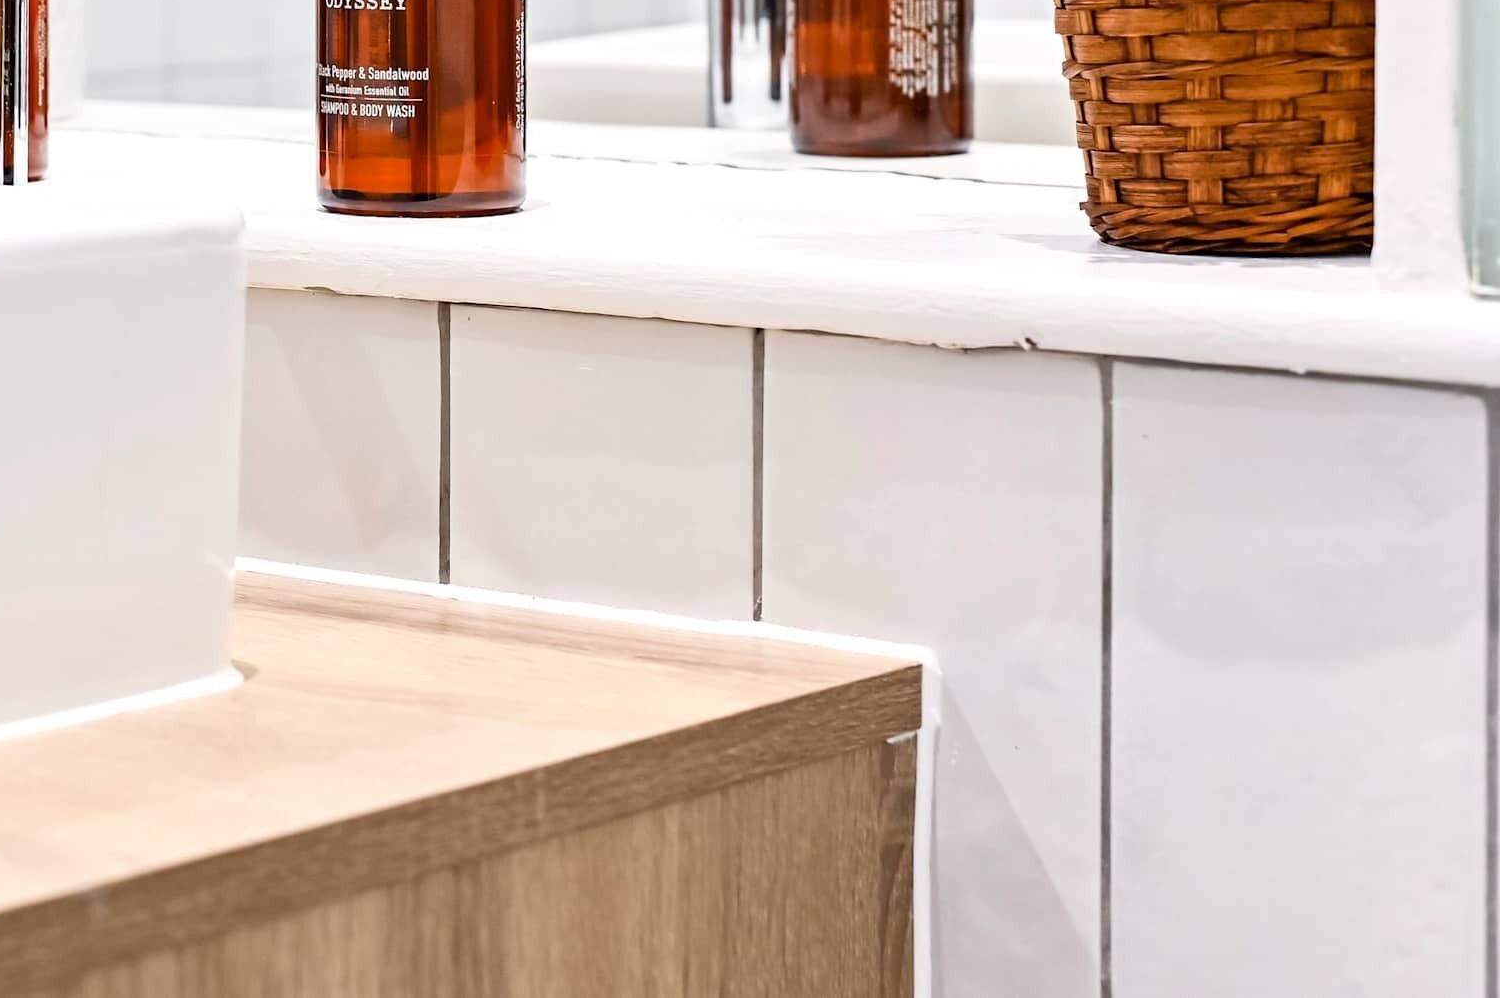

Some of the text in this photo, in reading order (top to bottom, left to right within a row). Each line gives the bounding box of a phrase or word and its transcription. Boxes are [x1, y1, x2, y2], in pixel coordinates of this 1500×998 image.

[332, 65, 357, 82] Pepper
[358, 66, 366, 80] &
[368, 66, 429, 81] Sandalwood
[364, 85, 397, 96] Essential
[398, 86, 410, 97] Oil
[321, 101, 416, 118] SHAMPOO & BODY WASH
